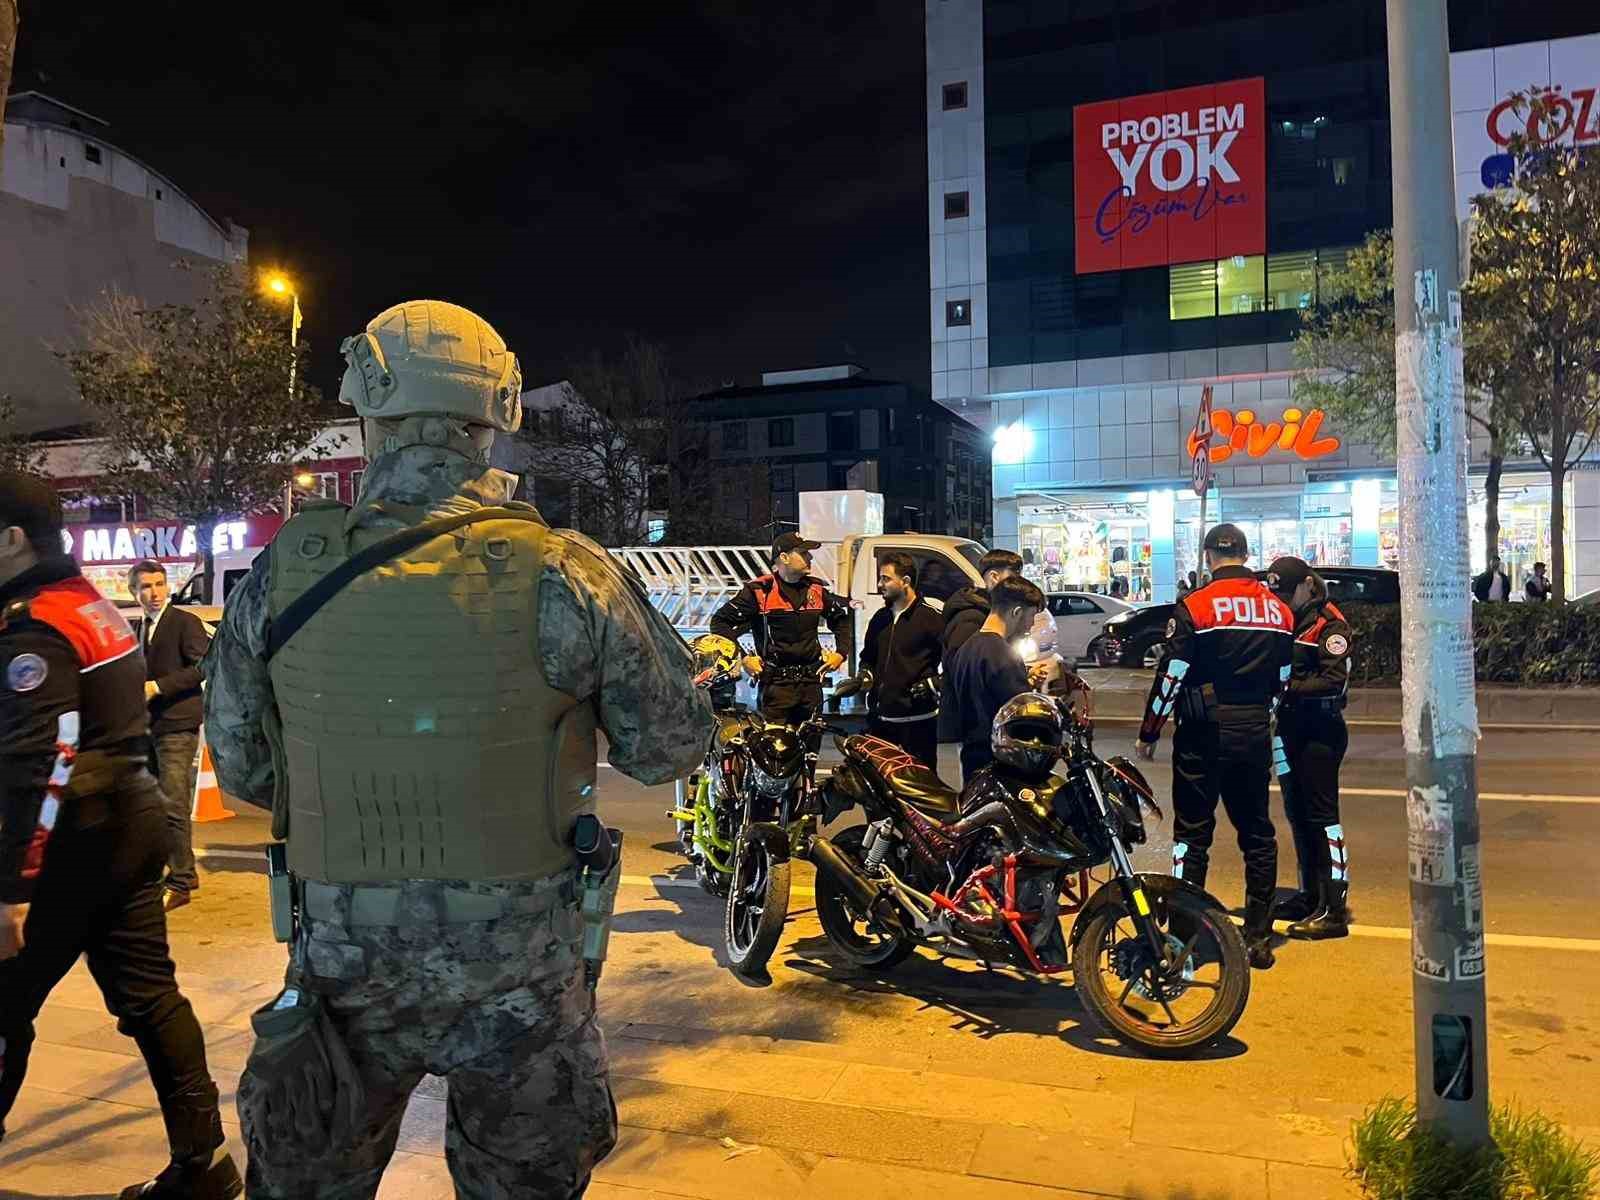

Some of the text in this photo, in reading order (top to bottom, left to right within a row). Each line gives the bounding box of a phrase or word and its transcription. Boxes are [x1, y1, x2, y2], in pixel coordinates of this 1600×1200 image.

[1102, 103, 1244, 148] PROBLEM
[1107, 130, 1241, 197] YOK
[1212, 593, 1283, 625] POLİS
